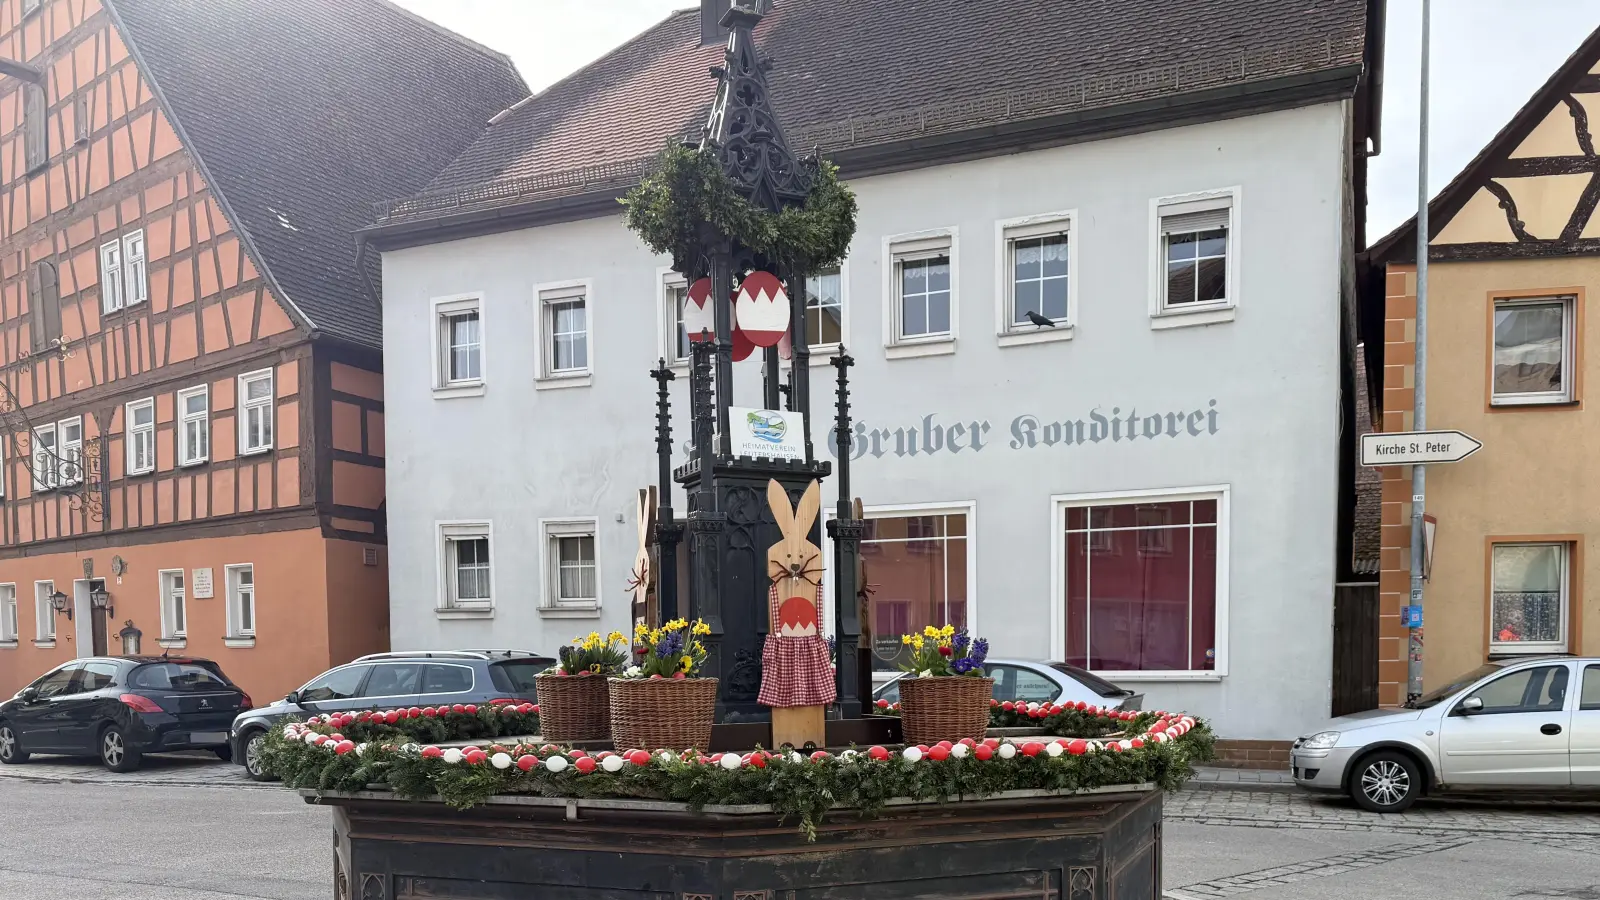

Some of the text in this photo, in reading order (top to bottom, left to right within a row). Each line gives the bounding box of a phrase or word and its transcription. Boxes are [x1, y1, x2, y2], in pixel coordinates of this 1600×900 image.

[827, 398, 1220, 462] Gruber Konditorei
[742, 443, 796, 452] HEIMATVEREIN
[1376, 442, 1451, 455] Kirche St. Peter
